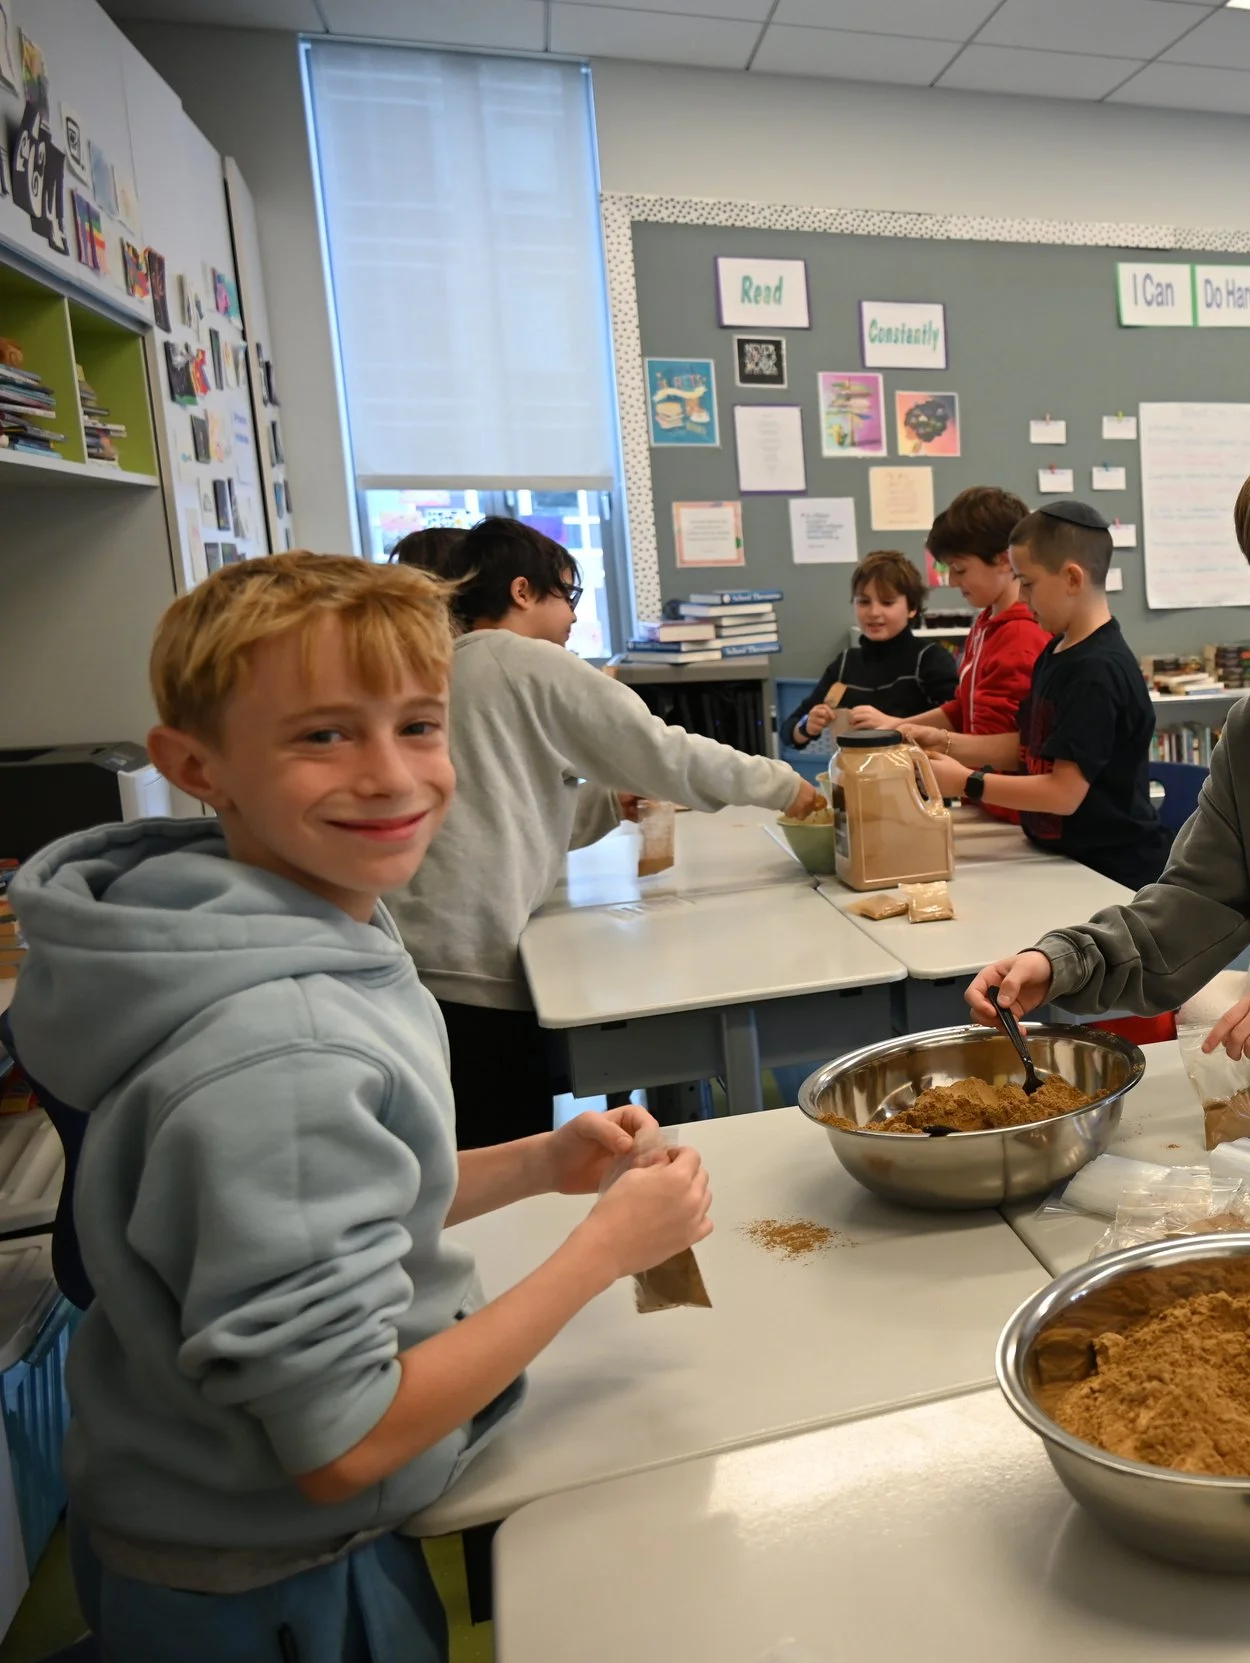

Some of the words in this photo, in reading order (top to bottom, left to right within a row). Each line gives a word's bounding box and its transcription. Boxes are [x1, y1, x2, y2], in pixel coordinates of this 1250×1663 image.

[740, 274, 784, 306] Read
[1133, 273, 1139, 307] I
[1142, 272, 1175, 308] Can
[1203, 278, 1222, 309] Do
[868, 318, 940, 353] Constantly
